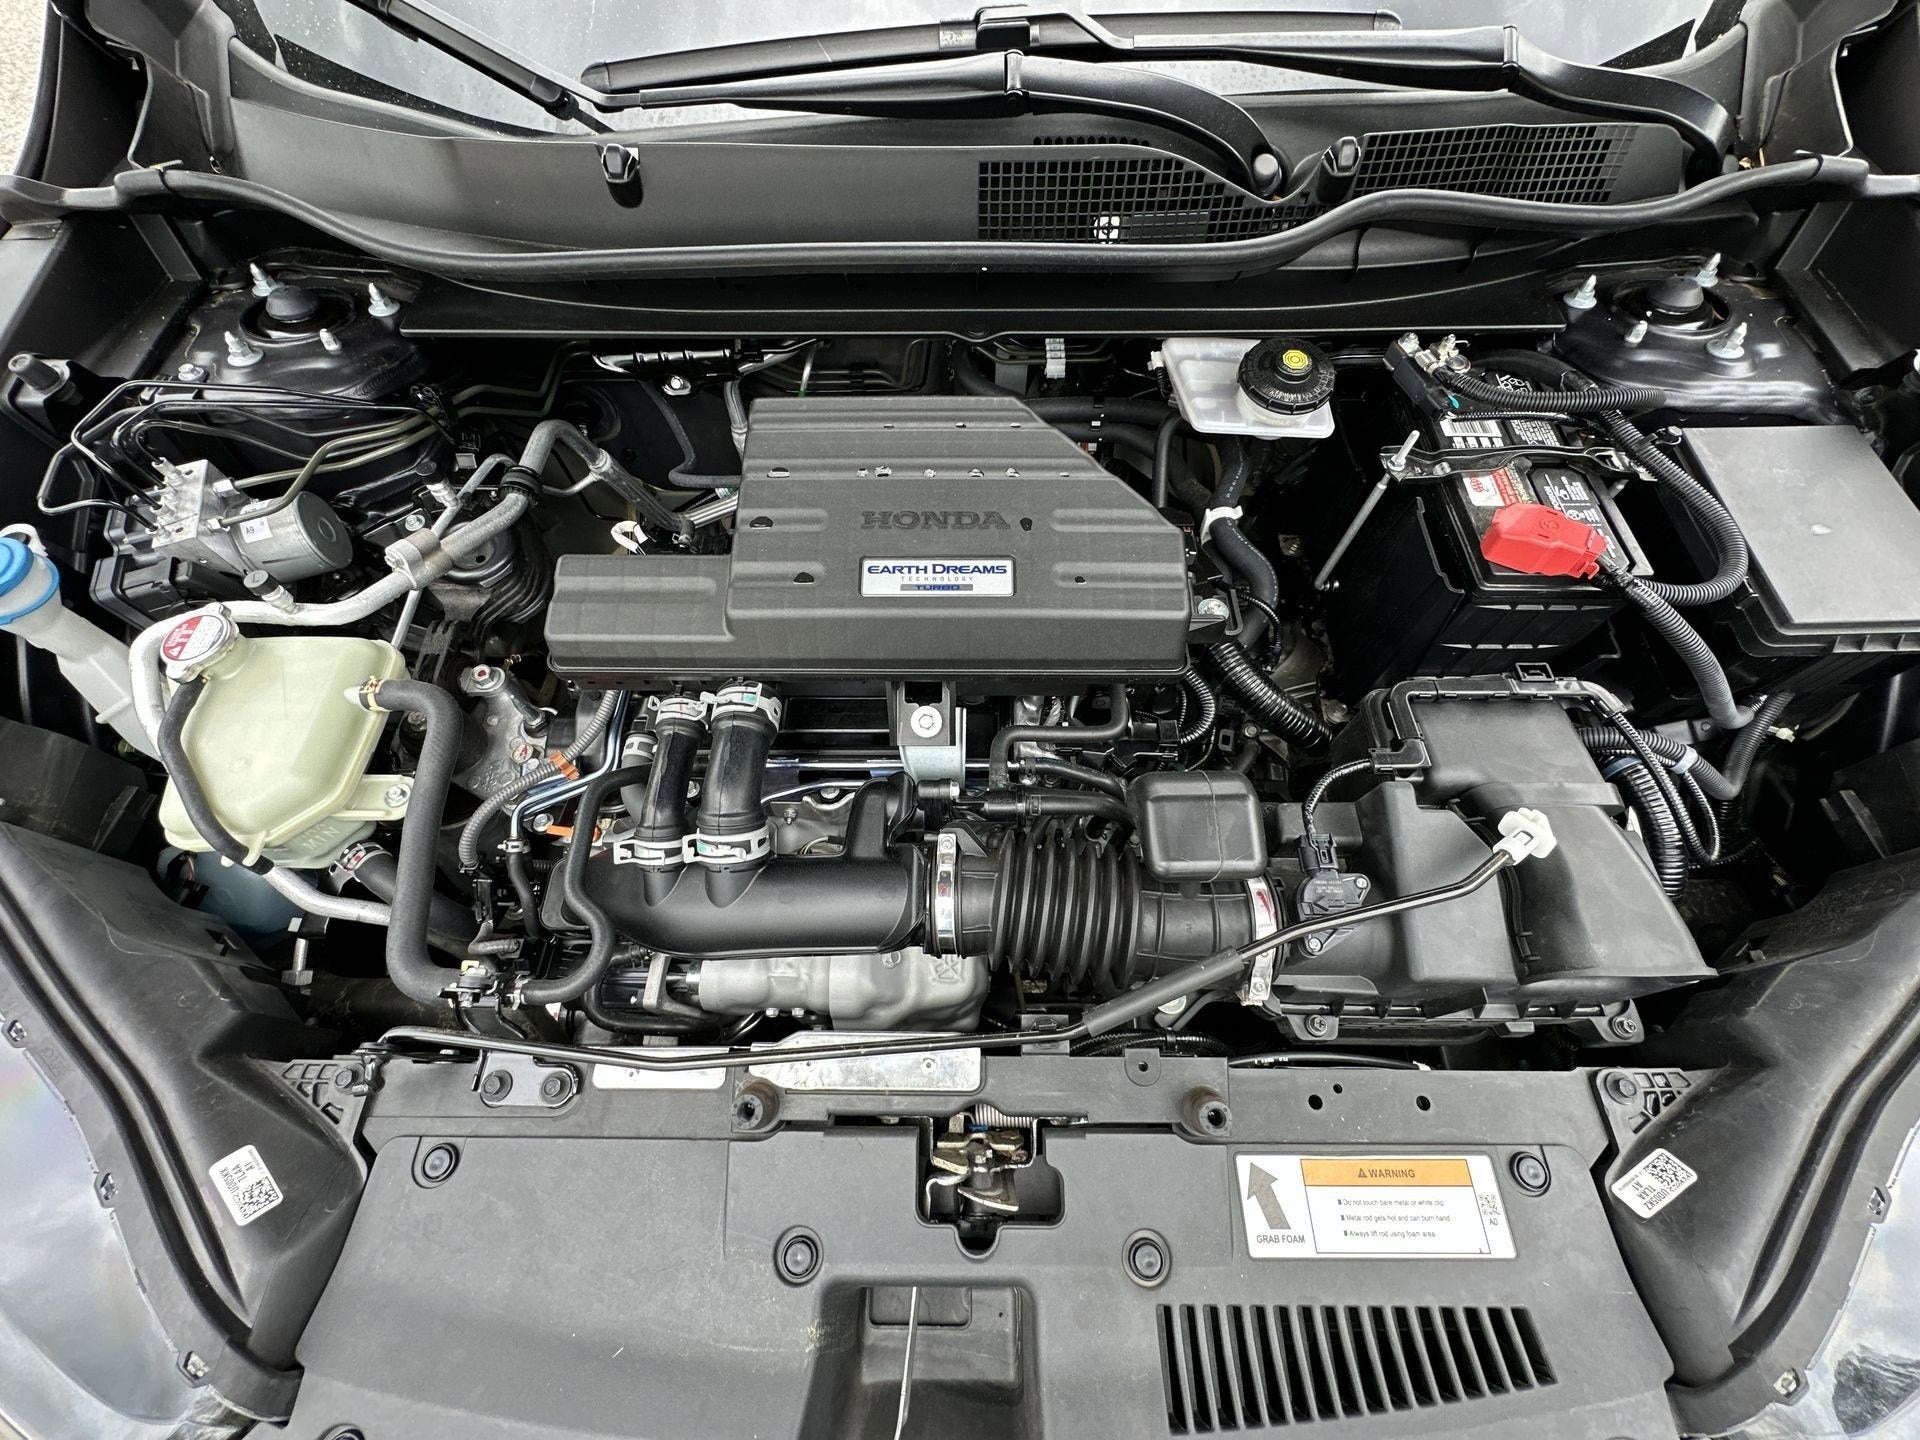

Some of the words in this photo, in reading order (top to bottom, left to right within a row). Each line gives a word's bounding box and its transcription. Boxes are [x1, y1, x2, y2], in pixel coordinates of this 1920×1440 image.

[861, 510, 1011, 529] HONDA
[867, 565, 928, 574] EARTH
[932, 563, 1007, 574] DREAMS
[1368, 1169, 1416, 1178] WARNING
[1257, 1235, 1279, 1243] GRAB
[1282, 1235, 1305, 1243] FOAM
